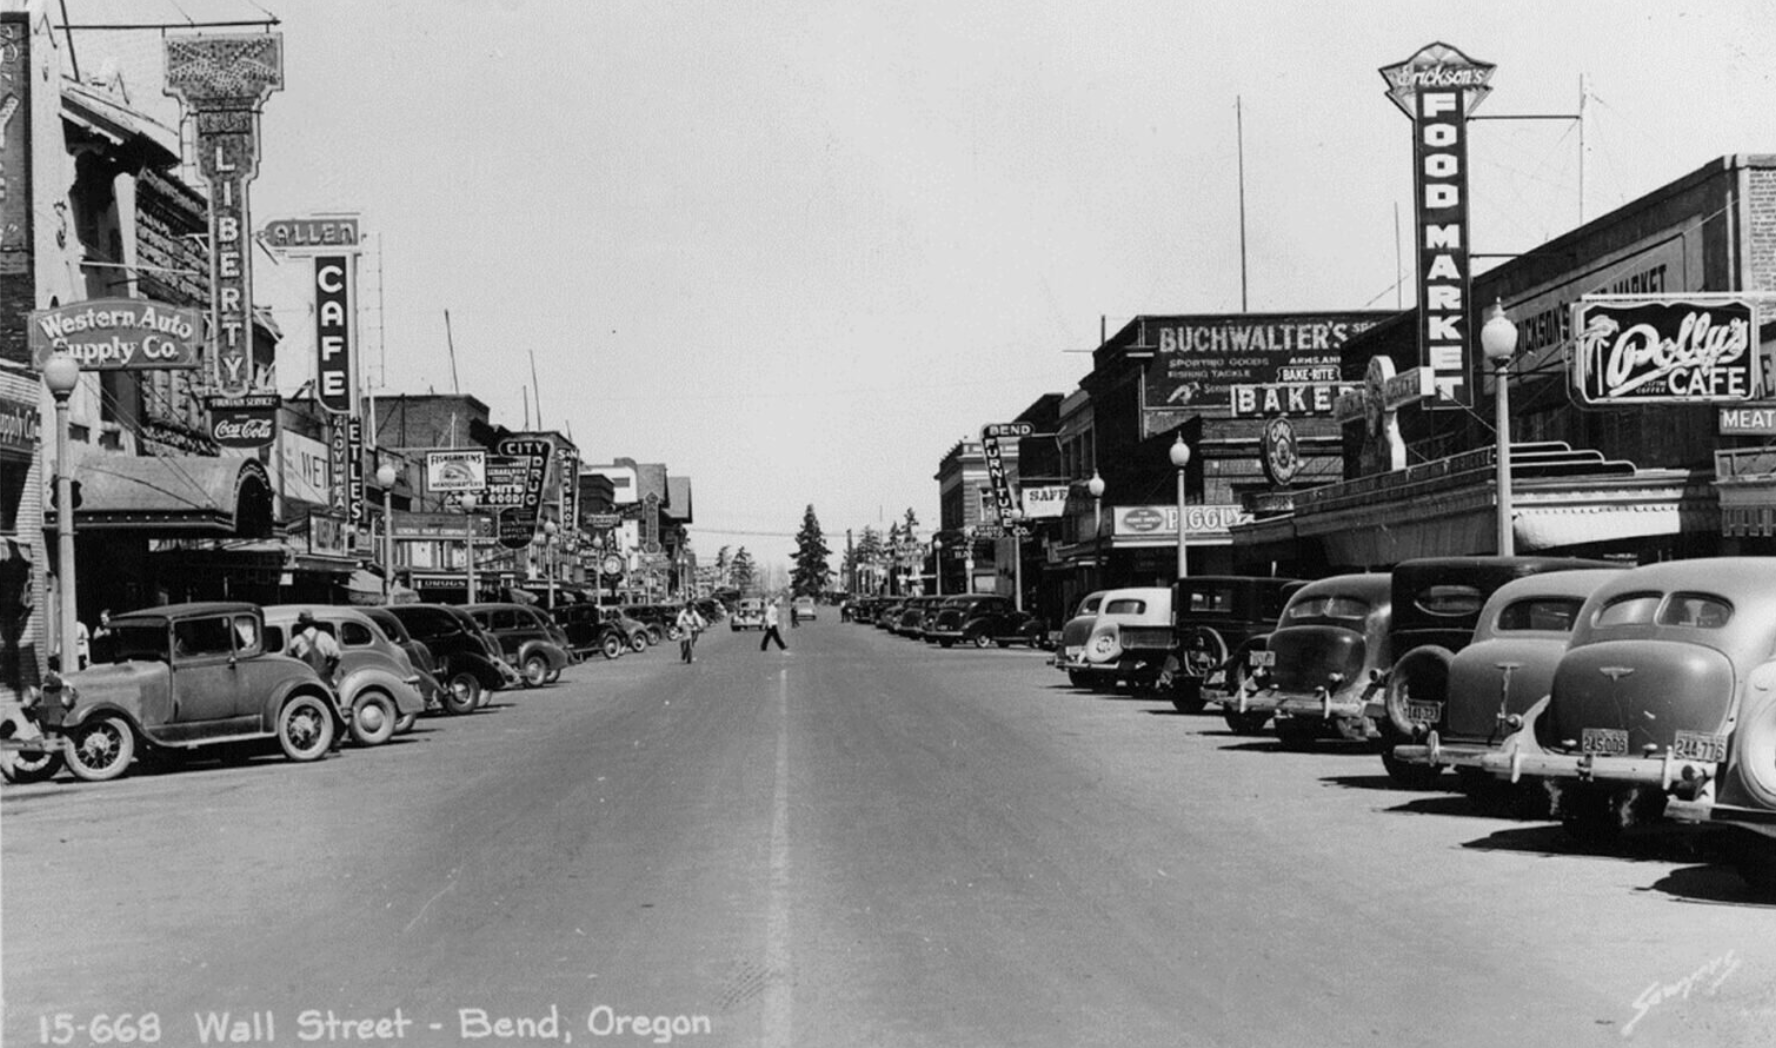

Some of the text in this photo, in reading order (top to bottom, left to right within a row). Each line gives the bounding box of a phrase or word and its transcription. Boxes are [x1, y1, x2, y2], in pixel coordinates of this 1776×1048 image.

[1397, 66, 1486, 87] Erickson's
[1422, 92, 1464, 401] FOOD MARKET
[214, 145, 244, 383] LIBERTY
[38, 306, 194, 342] Western Auto
[316, 264, 348, 397] CAFE
[1159, 322, 1350, 352] BUCHWALTER'S
[143, 335, 180, 360] Co.
[1605, 311, 1750, 390] Polly's
[1168, 357, 1270, 368] SPORTING GOODS
[1211, 369, 1251, 378] TACKLE
[1282, 368, 1335, 381] BAKE-RITE
[1668, 367, 1746, 396] CAFE
[213, 418, 273, 440] Coca-Cola
[989, 424, 1032, 436] BEND
[506, 442, 546, 455] CITY
[525, 456, 544, 506] DRUG
[984, 438, 1014, 527] FURNITURE
[1166, 510, 1246, 531] PGGLY
